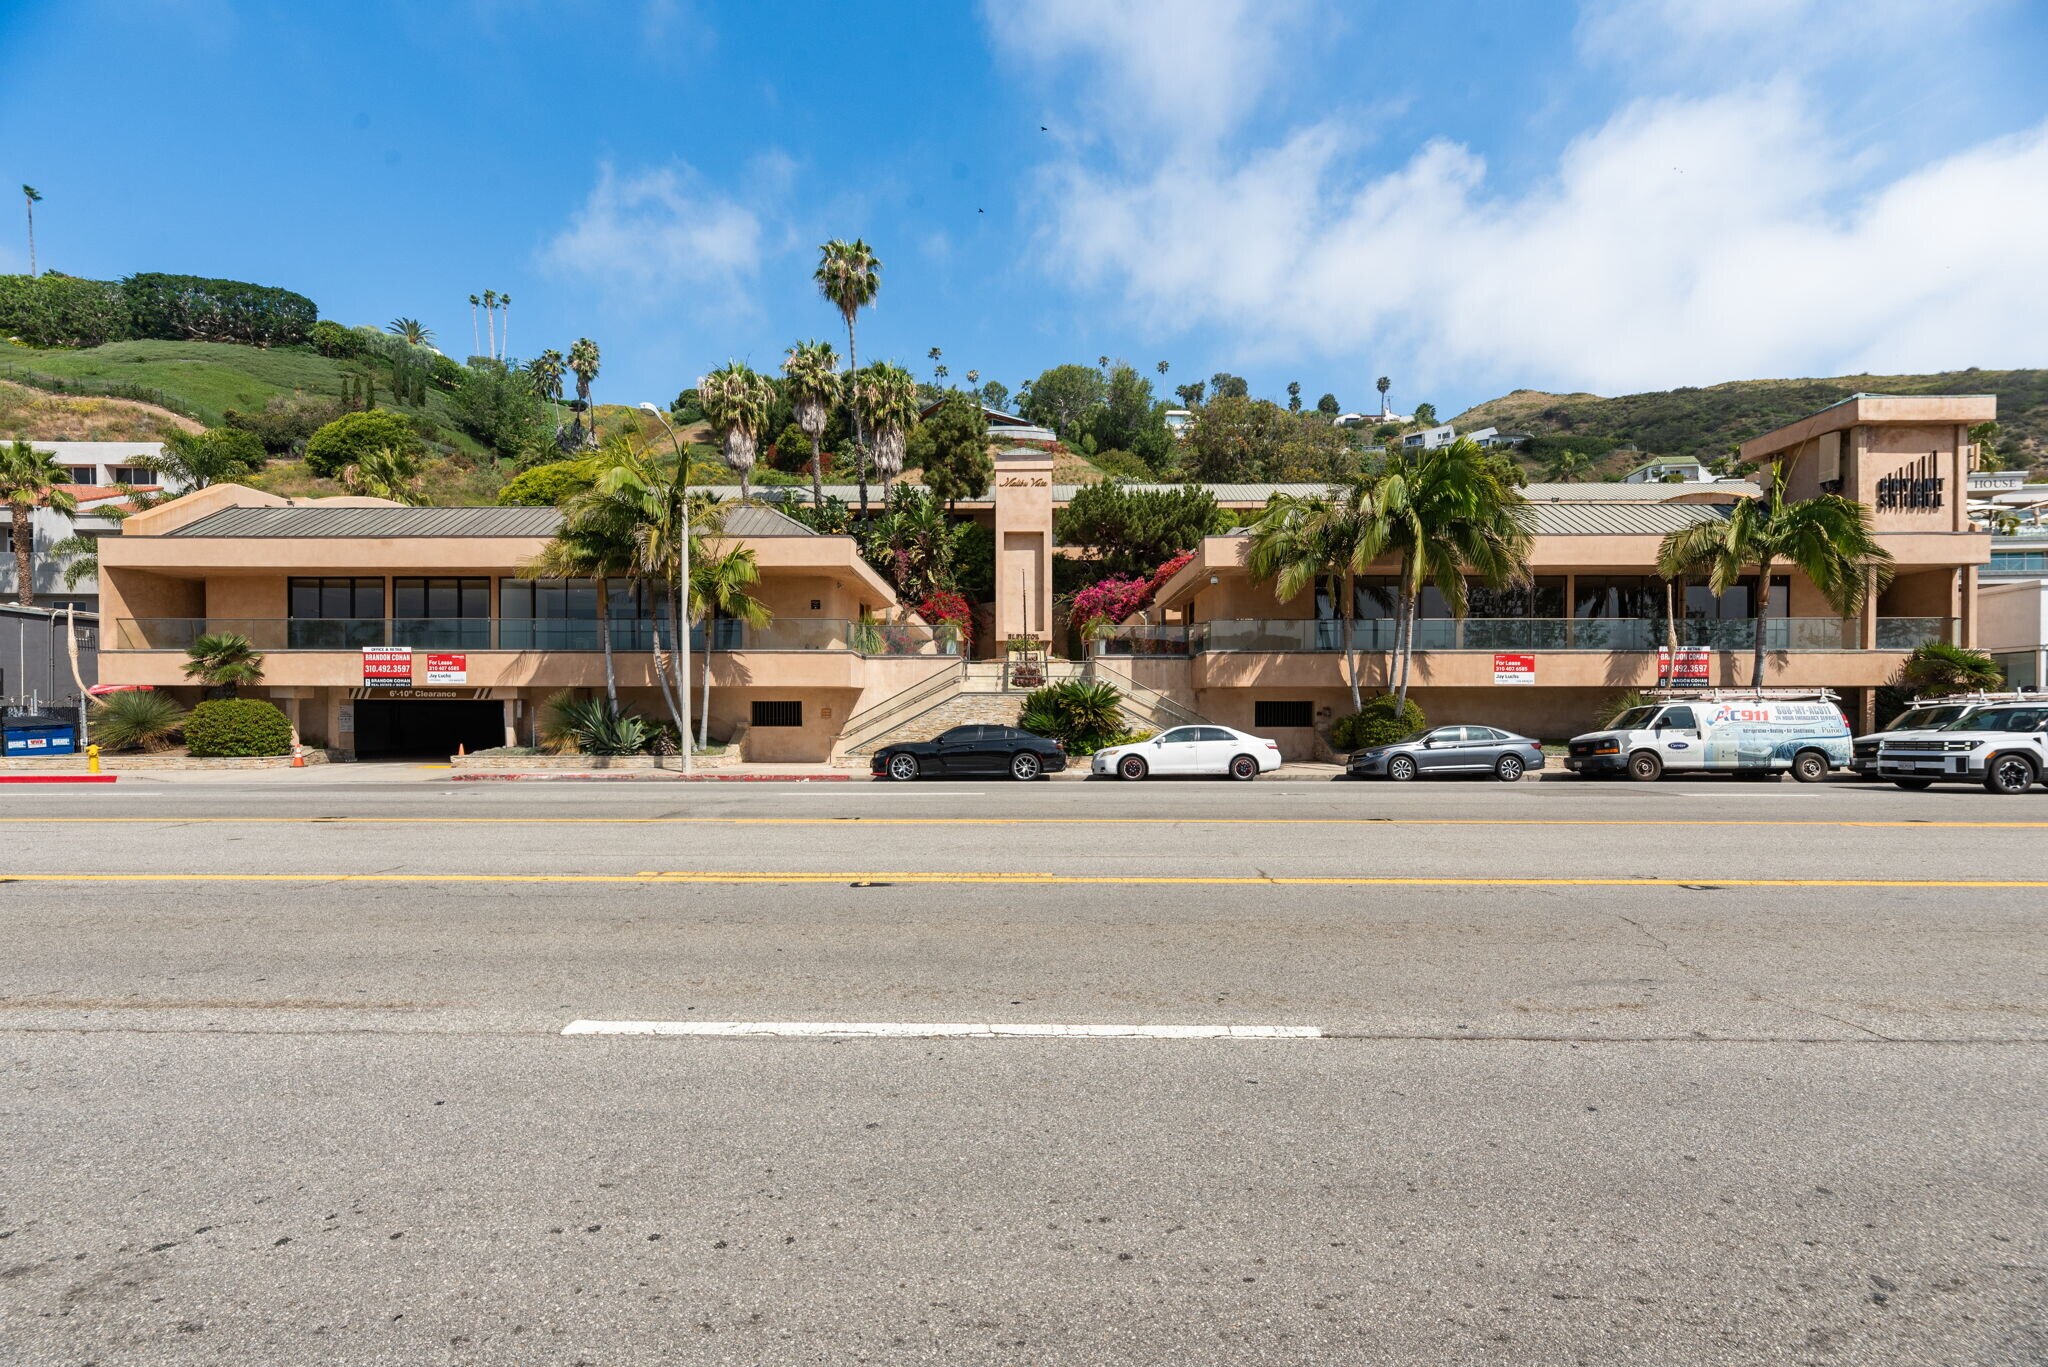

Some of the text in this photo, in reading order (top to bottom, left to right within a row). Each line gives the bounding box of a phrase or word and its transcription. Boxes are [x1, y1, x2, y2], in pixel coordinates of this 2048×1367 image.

[1974, 479, 2016, 489] HOUSE
[365, 653, 411, 661] BRANDON COHAN
[365, 664, 410, 673] 310.492.3597
[1660, 664, 1708, 672] 31492.3597
[1715, 710, 1768, 721] AC911
